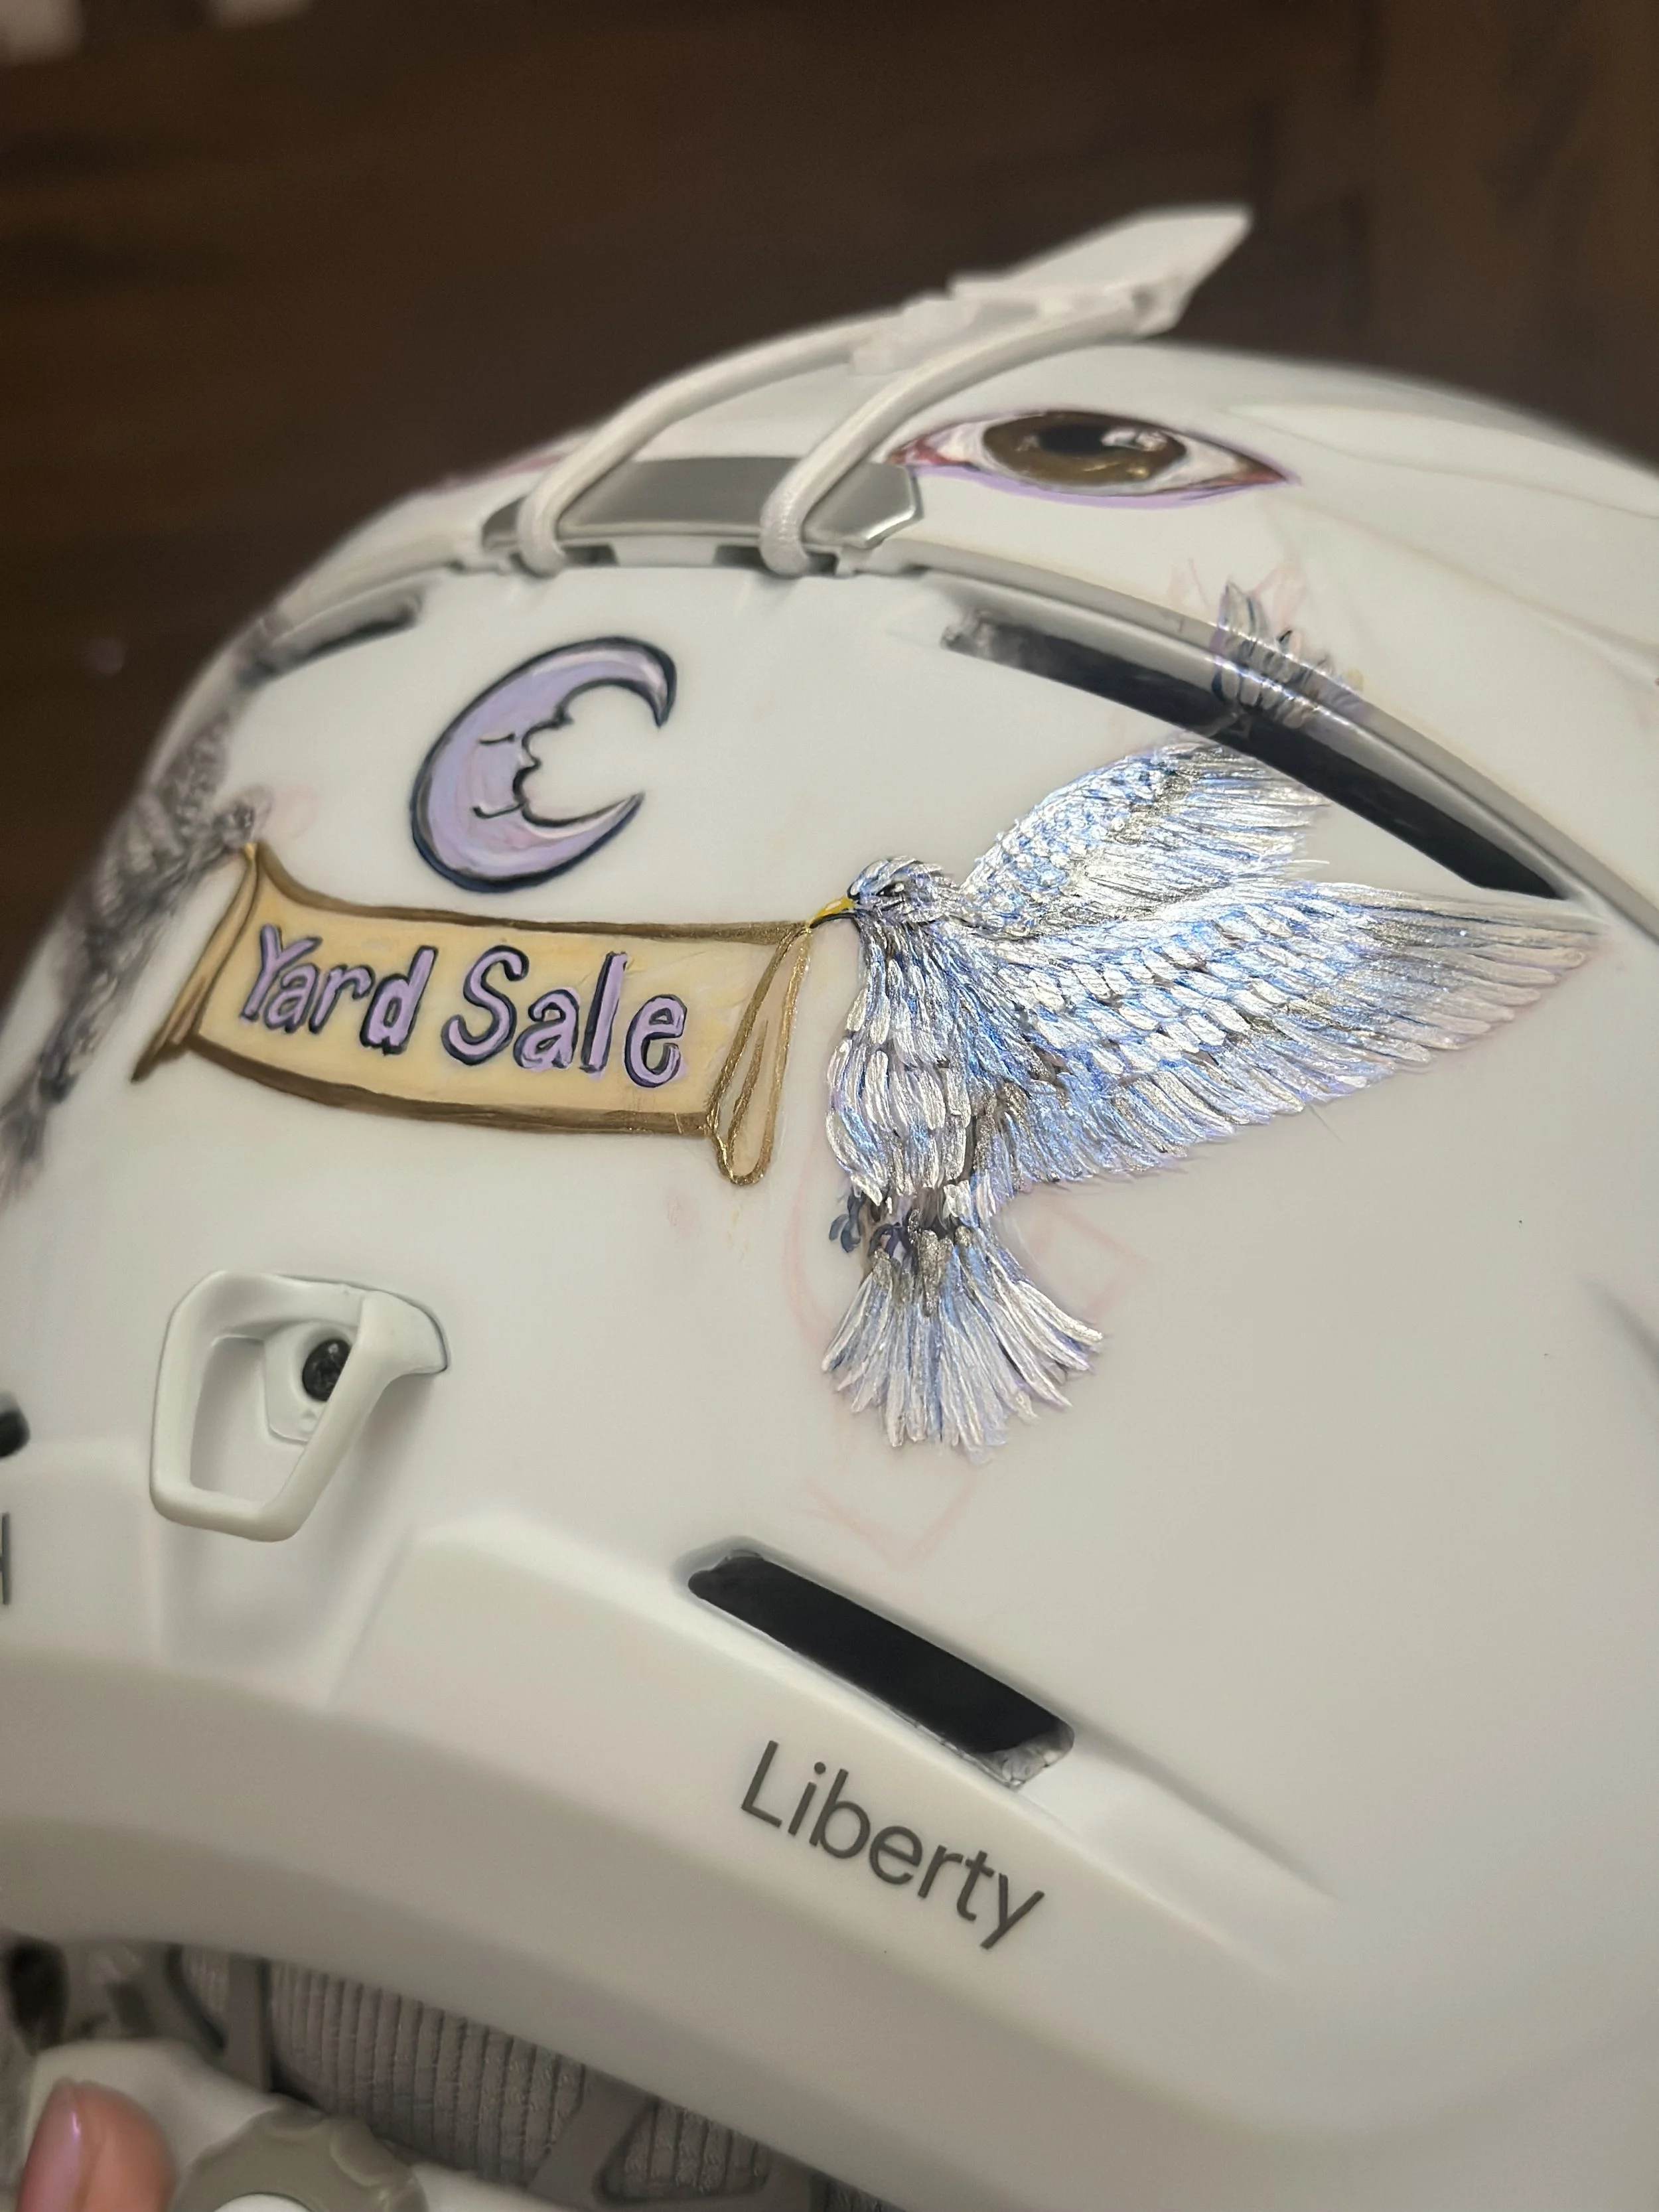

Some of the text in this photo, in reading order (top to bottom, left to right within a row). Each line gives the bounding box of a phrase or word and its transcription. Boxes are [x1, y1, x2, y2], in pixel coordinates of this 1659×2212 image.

[240, 924, 687, 1088] Yard Sale
[741, 1739, 1045, 1950] Liberty
